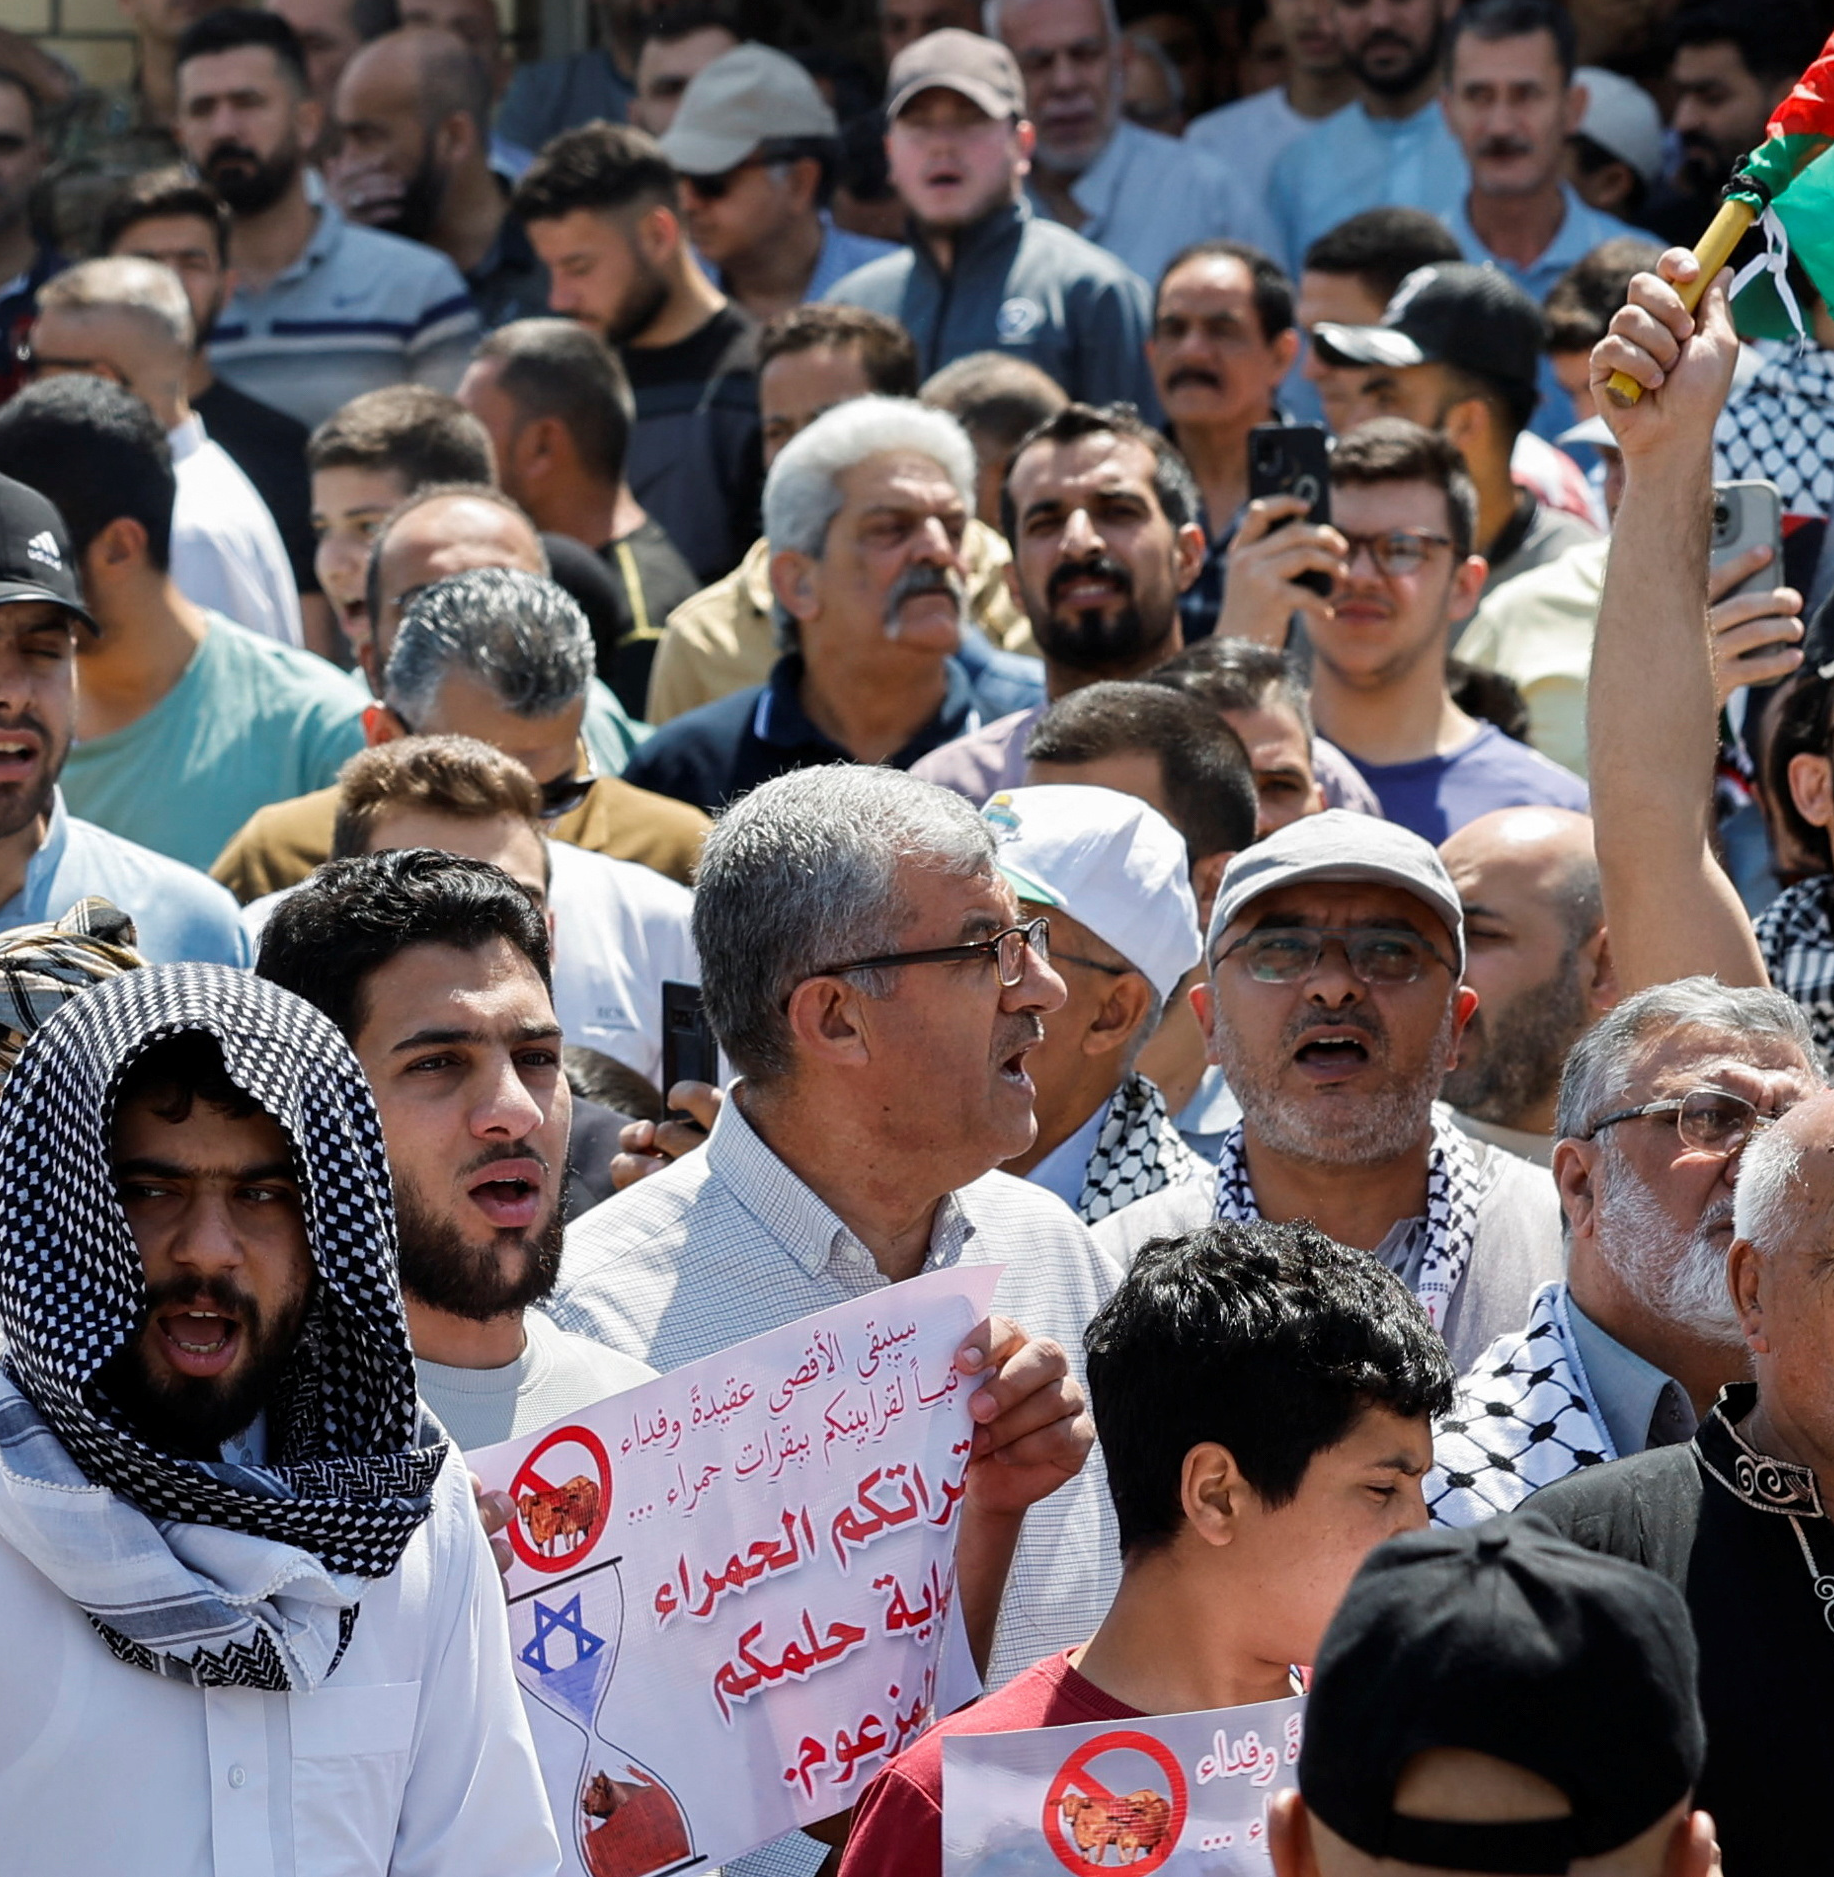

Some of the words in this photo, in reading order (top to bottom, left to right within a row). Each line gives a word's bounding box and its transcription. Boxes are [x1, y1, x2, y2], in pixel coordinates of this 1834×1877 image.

[769, 1329, 845, 1415] الأقصى
[857, 1320, 917, 1380] سيبقى
[620, 1408, 682, 1455] وفداء
[822, 1374, 905, 1465] لقرابينكم
[734, 1424, 811, 1478] ببقرات
[666, 1462, 723, 1511] حمراء
[653, 1504, 816, 1624] الحمراء
[713, 1607, 868, 1725] حلمكم
[1198, 1732, 1276, 1784] وفداء
